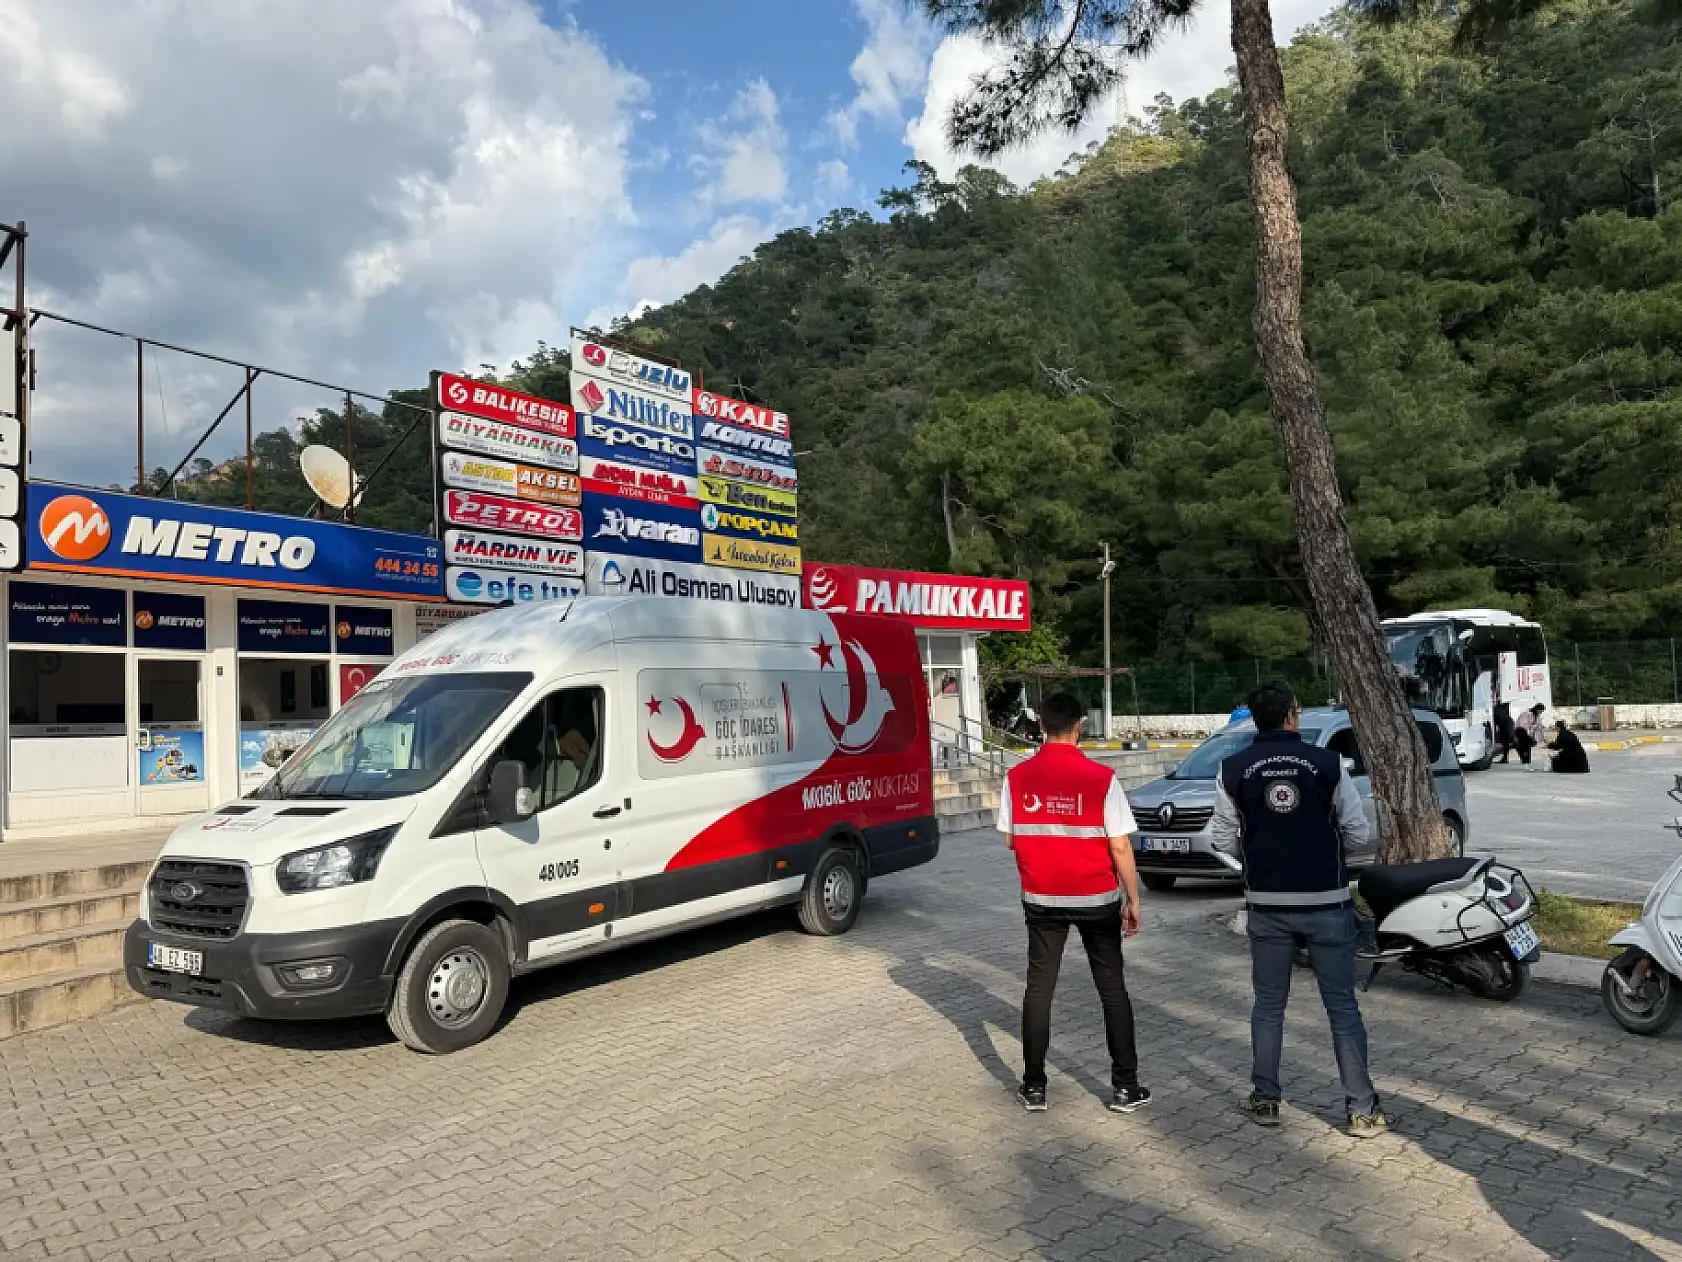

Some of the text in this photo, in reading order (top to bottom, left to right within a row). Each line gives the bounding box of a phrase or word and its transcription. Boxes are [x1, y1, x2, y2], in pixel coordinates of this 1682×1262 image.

[720, 400, 788, 434] KALE
[701, 422, 792, 457] KONTUR
[518, 468, 579, 492] AKSEL
[727, 483, 768, 508] Ben
[456, 501, 577, 531] PETROL
[626, 516, 699, 546] varan
[719, 511, 798, 538] TOPÇAM
[121, 515, 317, 571] METRO
[454, 538, 541, 562] MARDİN
[375, 557, 400, 573] 444
[488, 577, 535, 601] efe
[629, 567, 798, 609] Ali Osman Ulusoy
[855, 578, 1025, 621] PAMUKKALE
[158, 615, 206, 629] METRO
[715, 712, 779, 743] GÖÇ İDARESİ
[715, 739, 780, 761] BAŞKANLIĞI
[802, 780, 846, 811] MOBİL
[873, 772, 920, 799] NOKTASI
